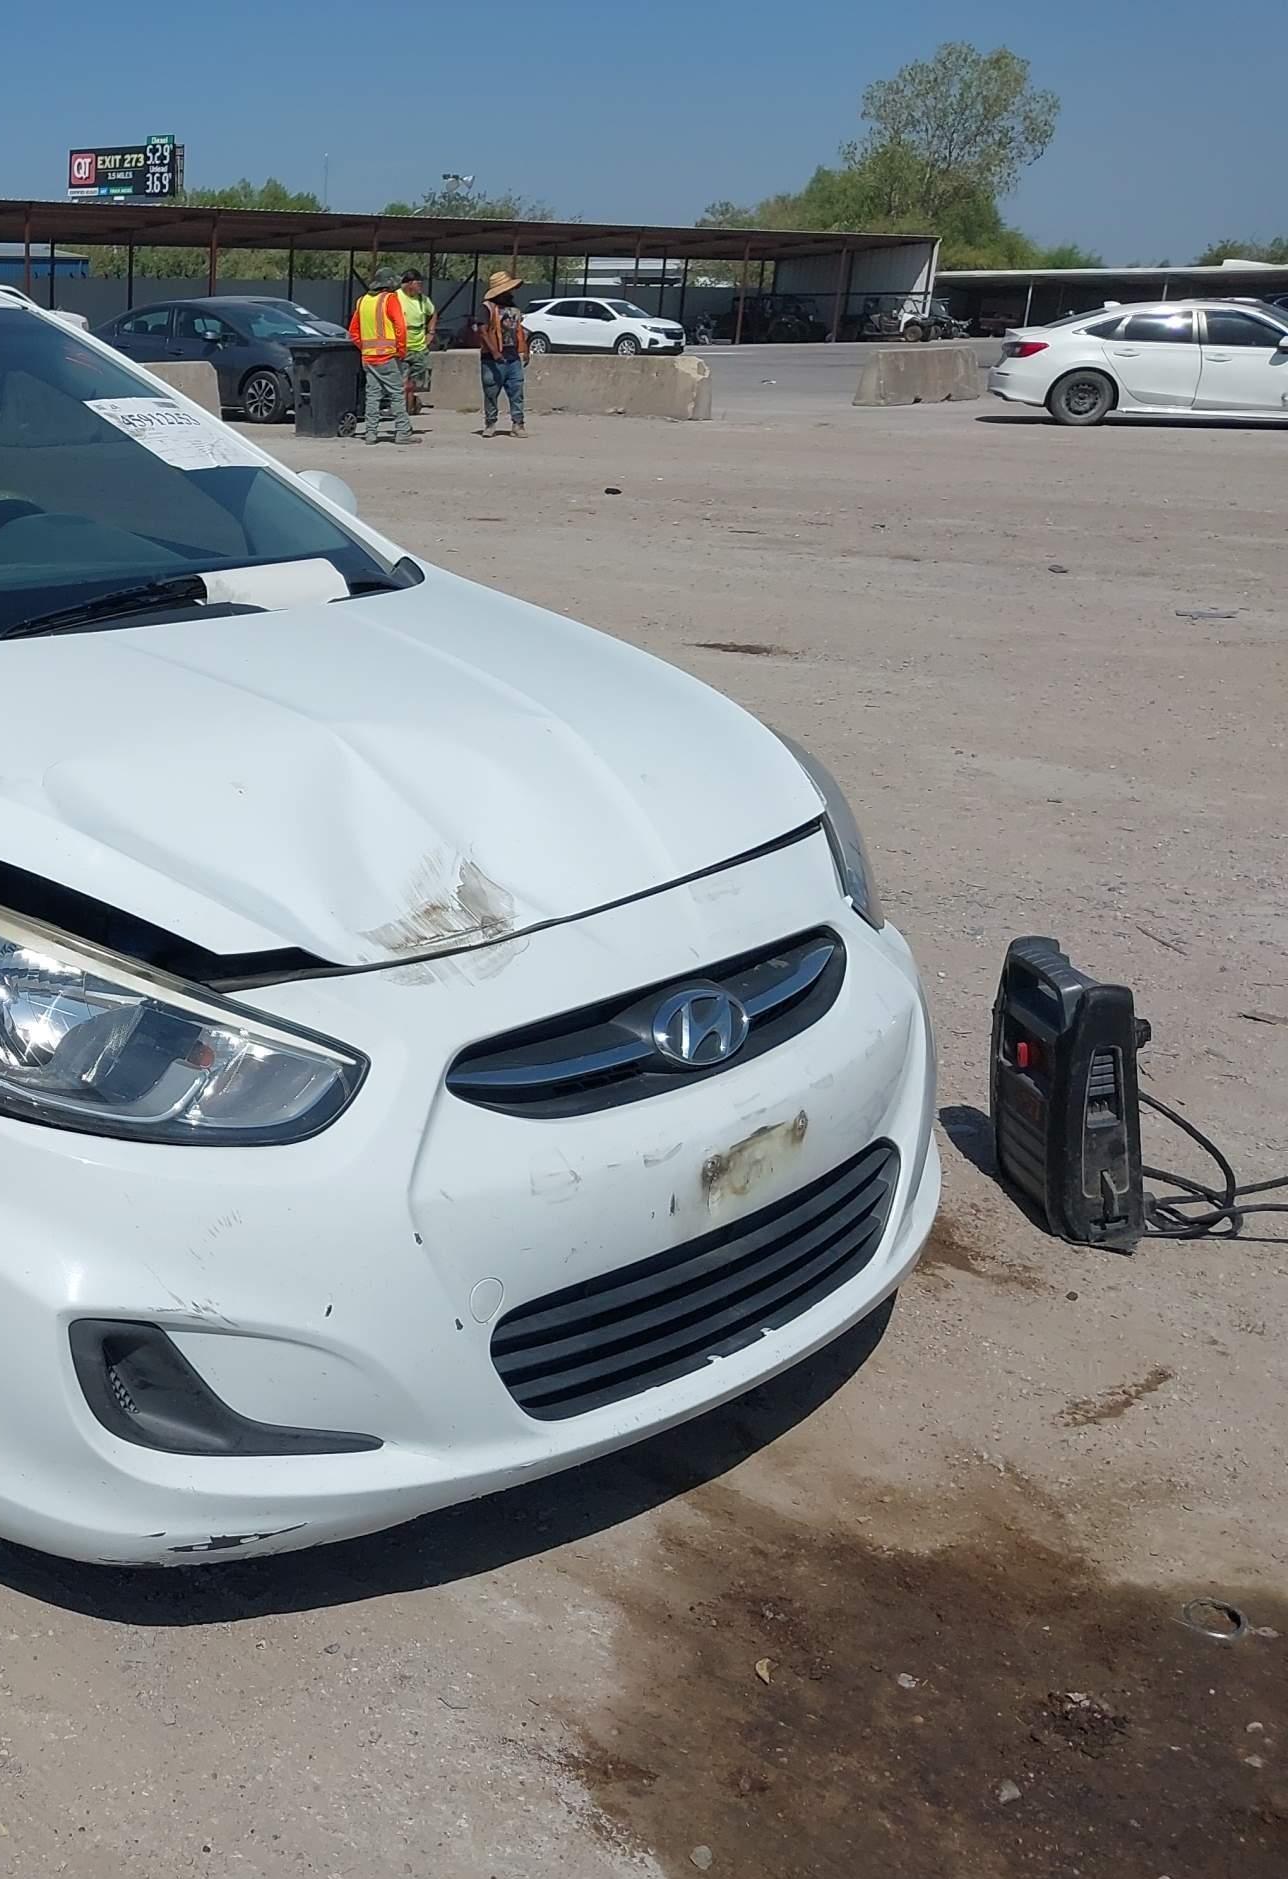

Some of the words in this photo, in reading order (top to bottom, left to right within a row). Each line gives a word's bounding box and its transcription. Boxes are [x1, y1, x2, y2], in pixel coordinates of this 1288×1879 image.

[73, 158, 91, 179] QT
[97, 155, 121, 169] EXIT
[123, 153, 144, 168] 273
